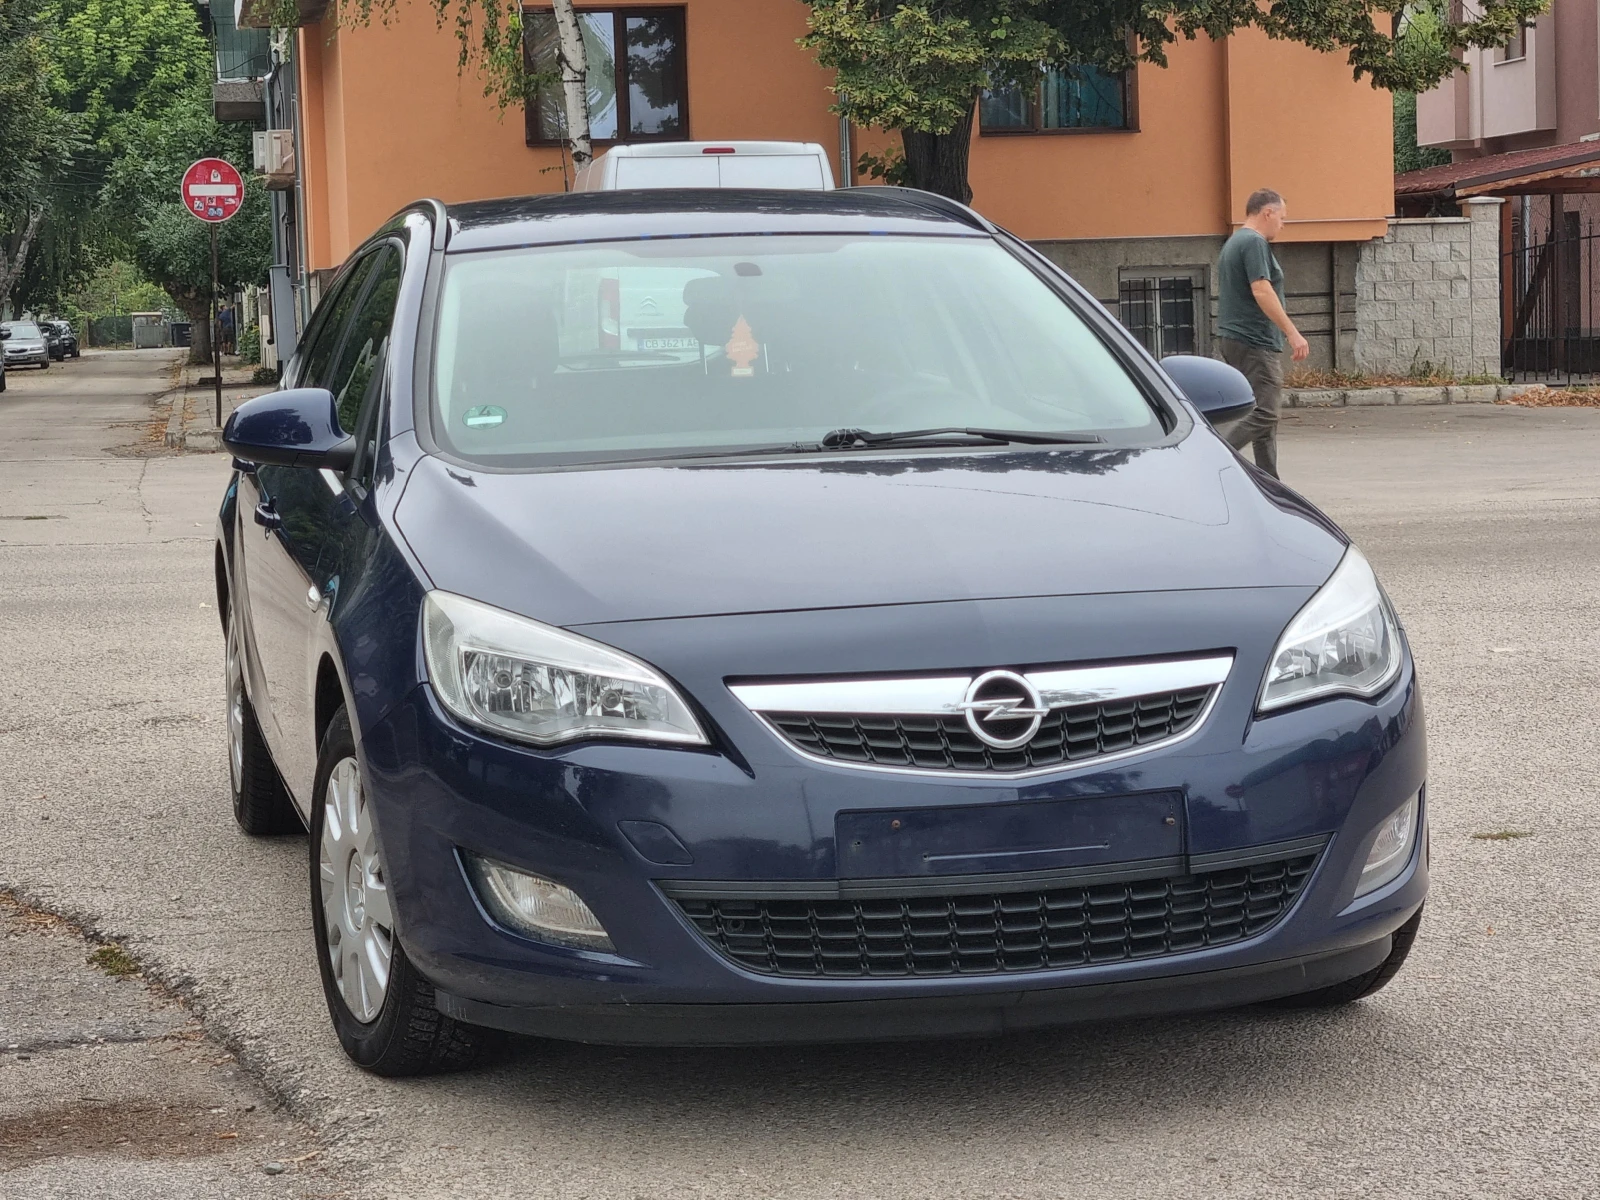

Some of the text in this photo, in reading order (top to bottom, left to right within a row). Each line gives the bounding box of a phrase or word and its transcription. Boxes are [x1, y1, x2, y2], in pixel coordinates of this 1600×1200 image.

[645, 339, 659, 349] CB
[660, 338, 685, 348] 3621
[478, 405, 492, 417] 4
